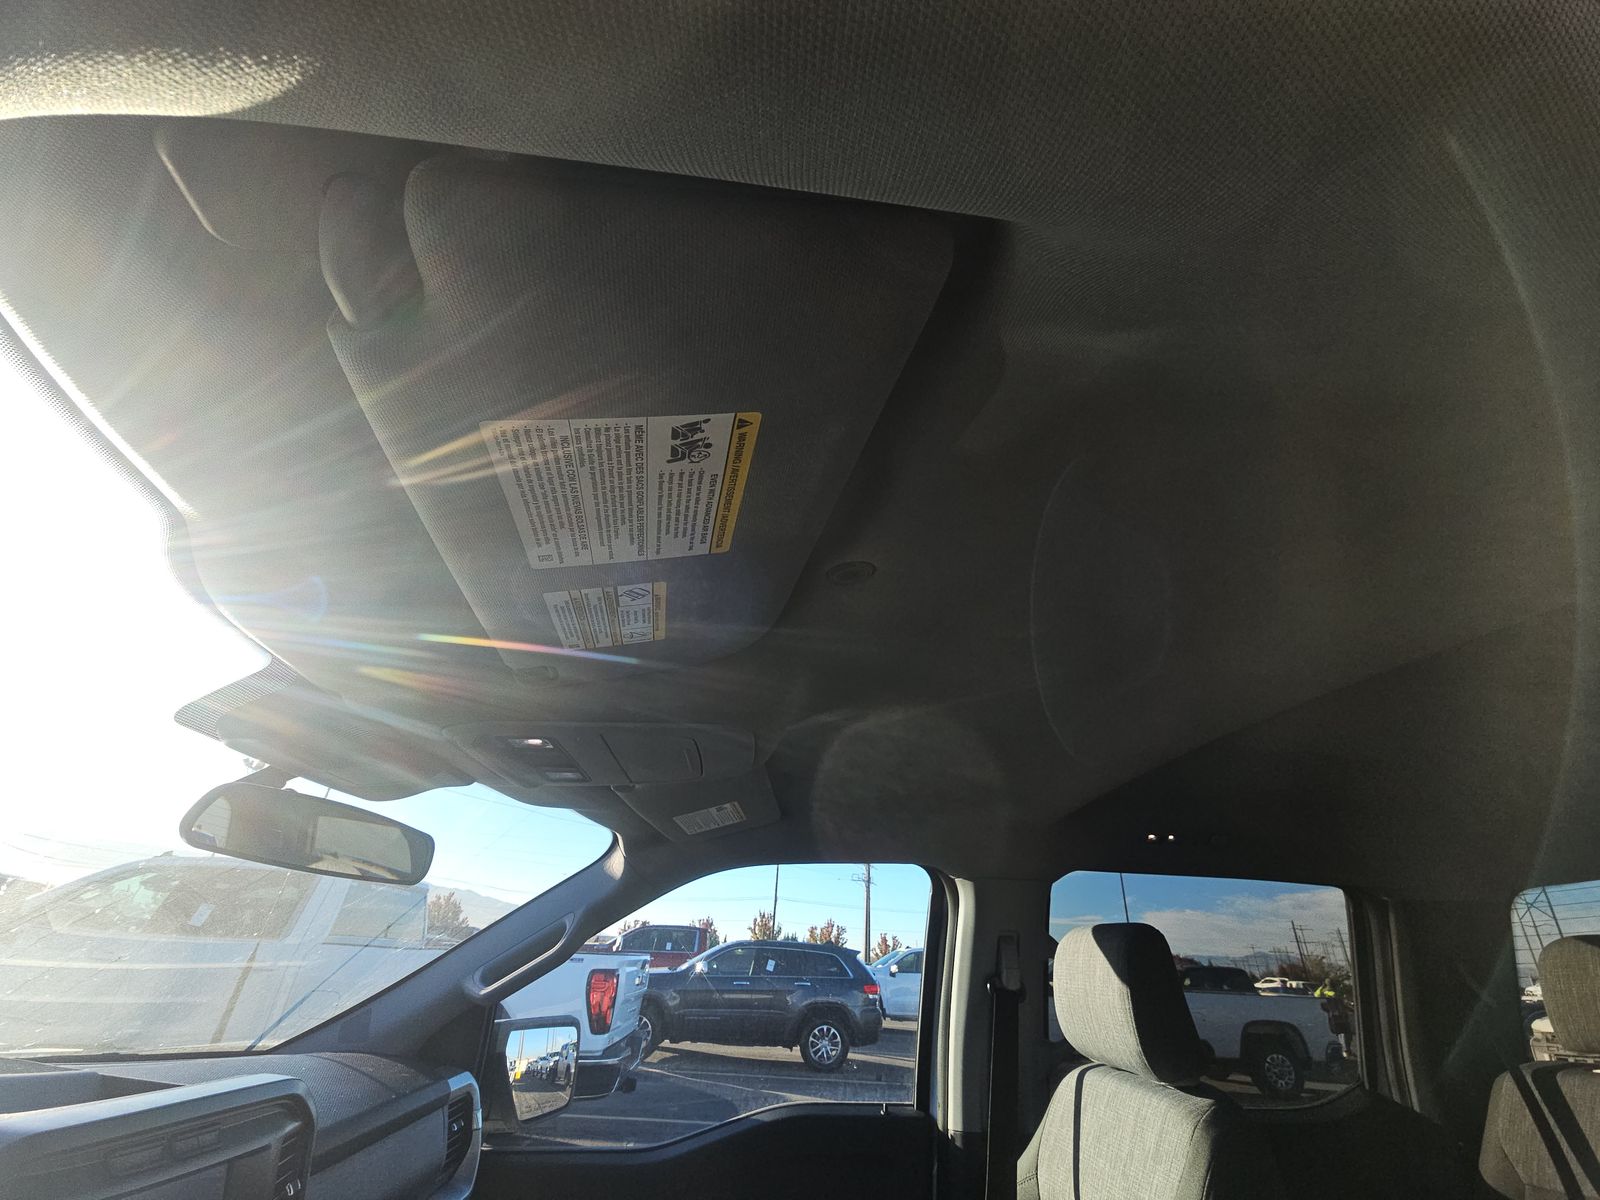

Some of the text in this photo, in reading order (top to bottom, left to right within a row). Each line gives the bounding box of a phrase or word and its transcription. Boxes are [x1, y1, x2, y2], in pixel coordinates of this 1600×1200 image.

[634, 424, 645, 443] MÊME
[558, 435, 574, 467] INCLUSIVE
[634, 444, 643, 461] AVEC
[731, 432, 747, 464] WARNING
[565, 469, 576, 481] CON
[635, 462, 643, 474] DES
[568, 482, 578, 493] LAS
[635, 475, 643, 489] SACS
[708, 473, 718, 487] EVEN
[721, 467, 739, 513] AVERTISSEMENT
[570, 494, 582, 514] NUEVAS
[635, 490, 644, 522] GONFLABLES
[702, 500, 713, 524] ADVANCED
